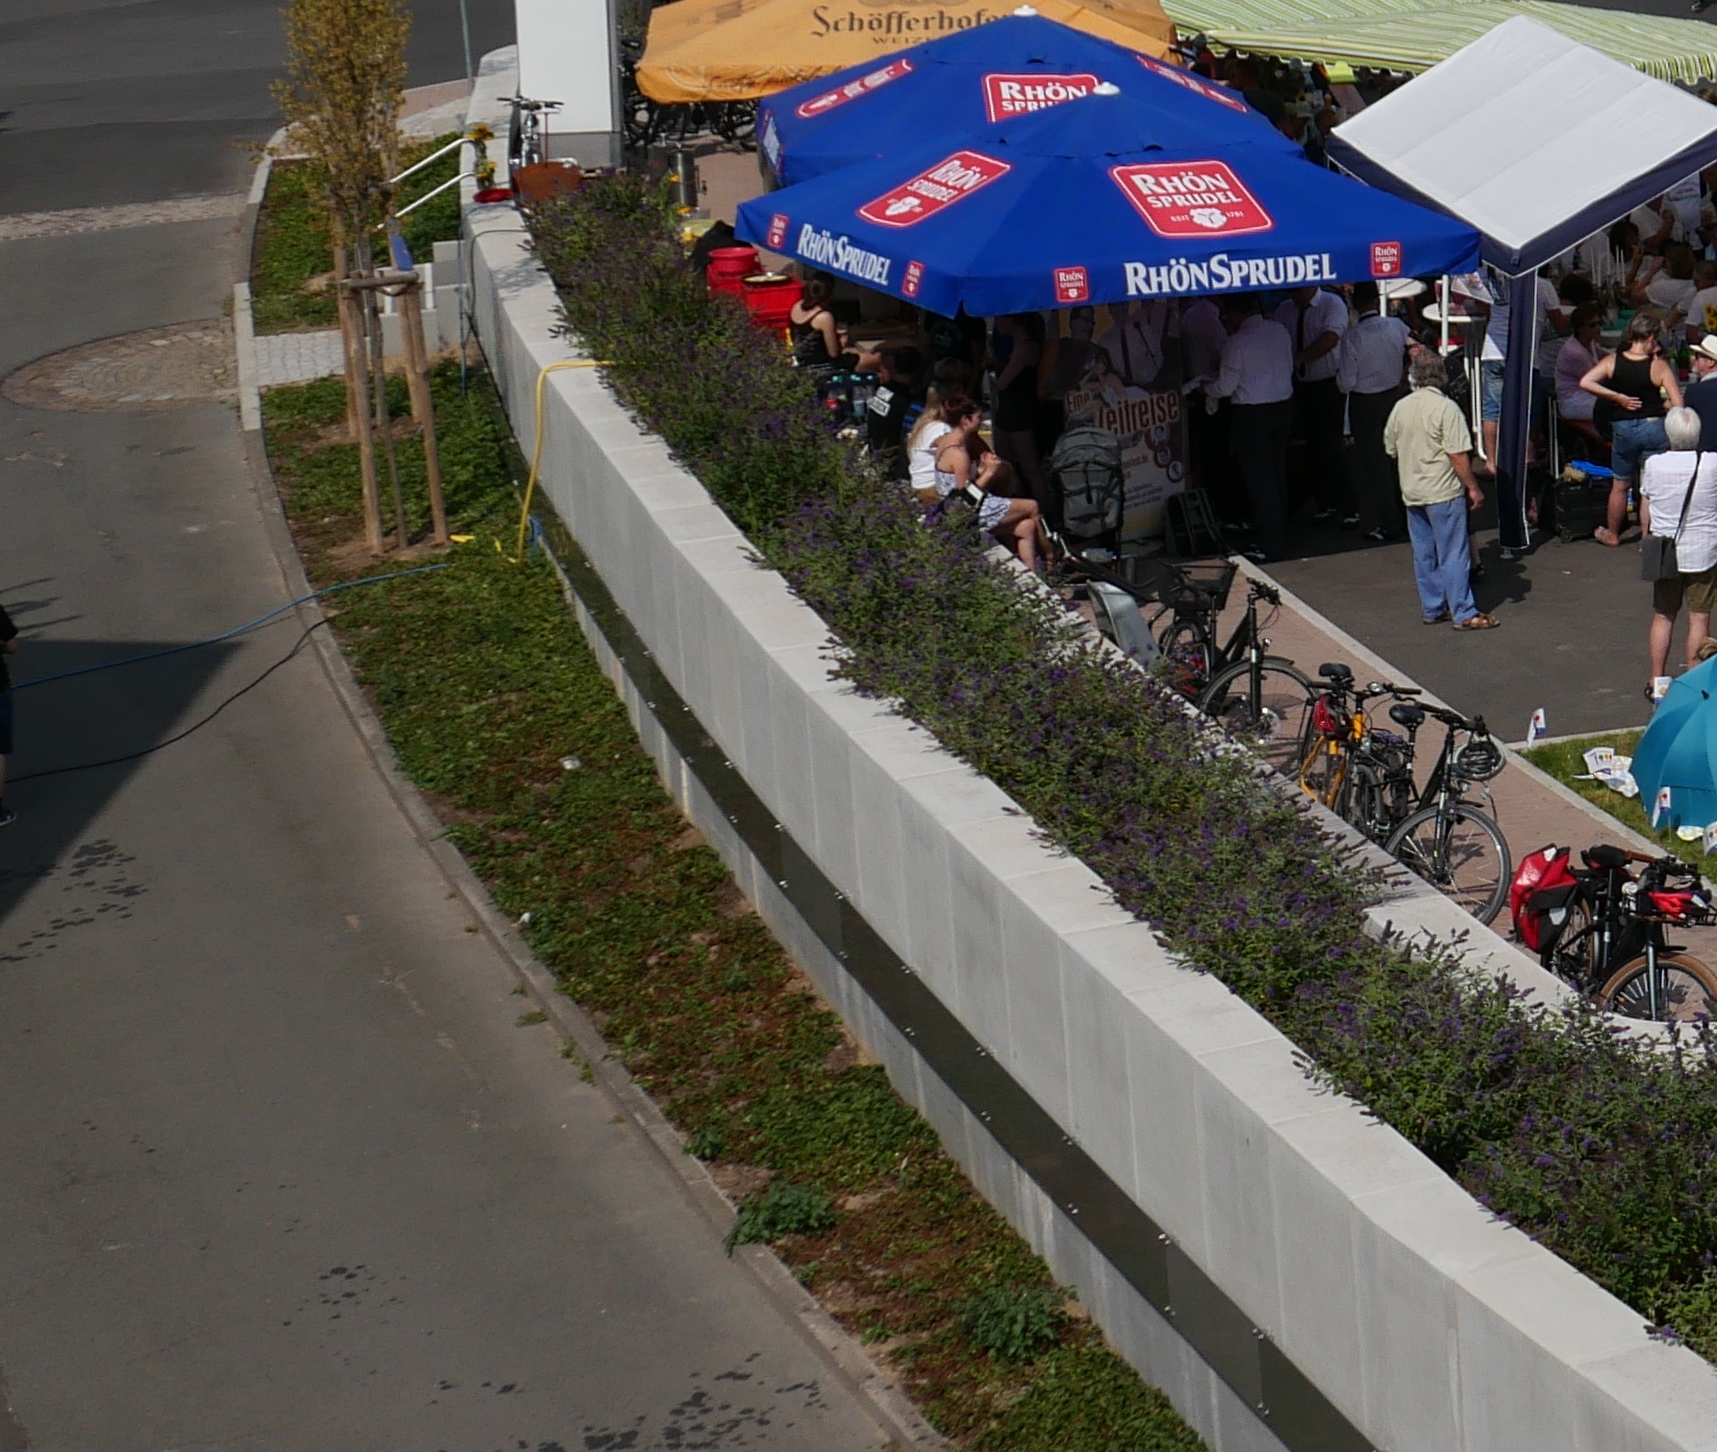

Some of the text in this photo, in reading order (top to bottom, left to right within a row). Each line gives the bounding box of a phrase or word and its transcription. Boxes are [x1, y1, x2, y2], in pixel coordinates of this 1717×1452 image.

[999, 81, 1087, 101] RHÖN
[927, 159, 988, 191] RHÖN
[1129, 171, 1230, 195] RHÖN
[1146, 190, 1243, 208] SPRUDEL
